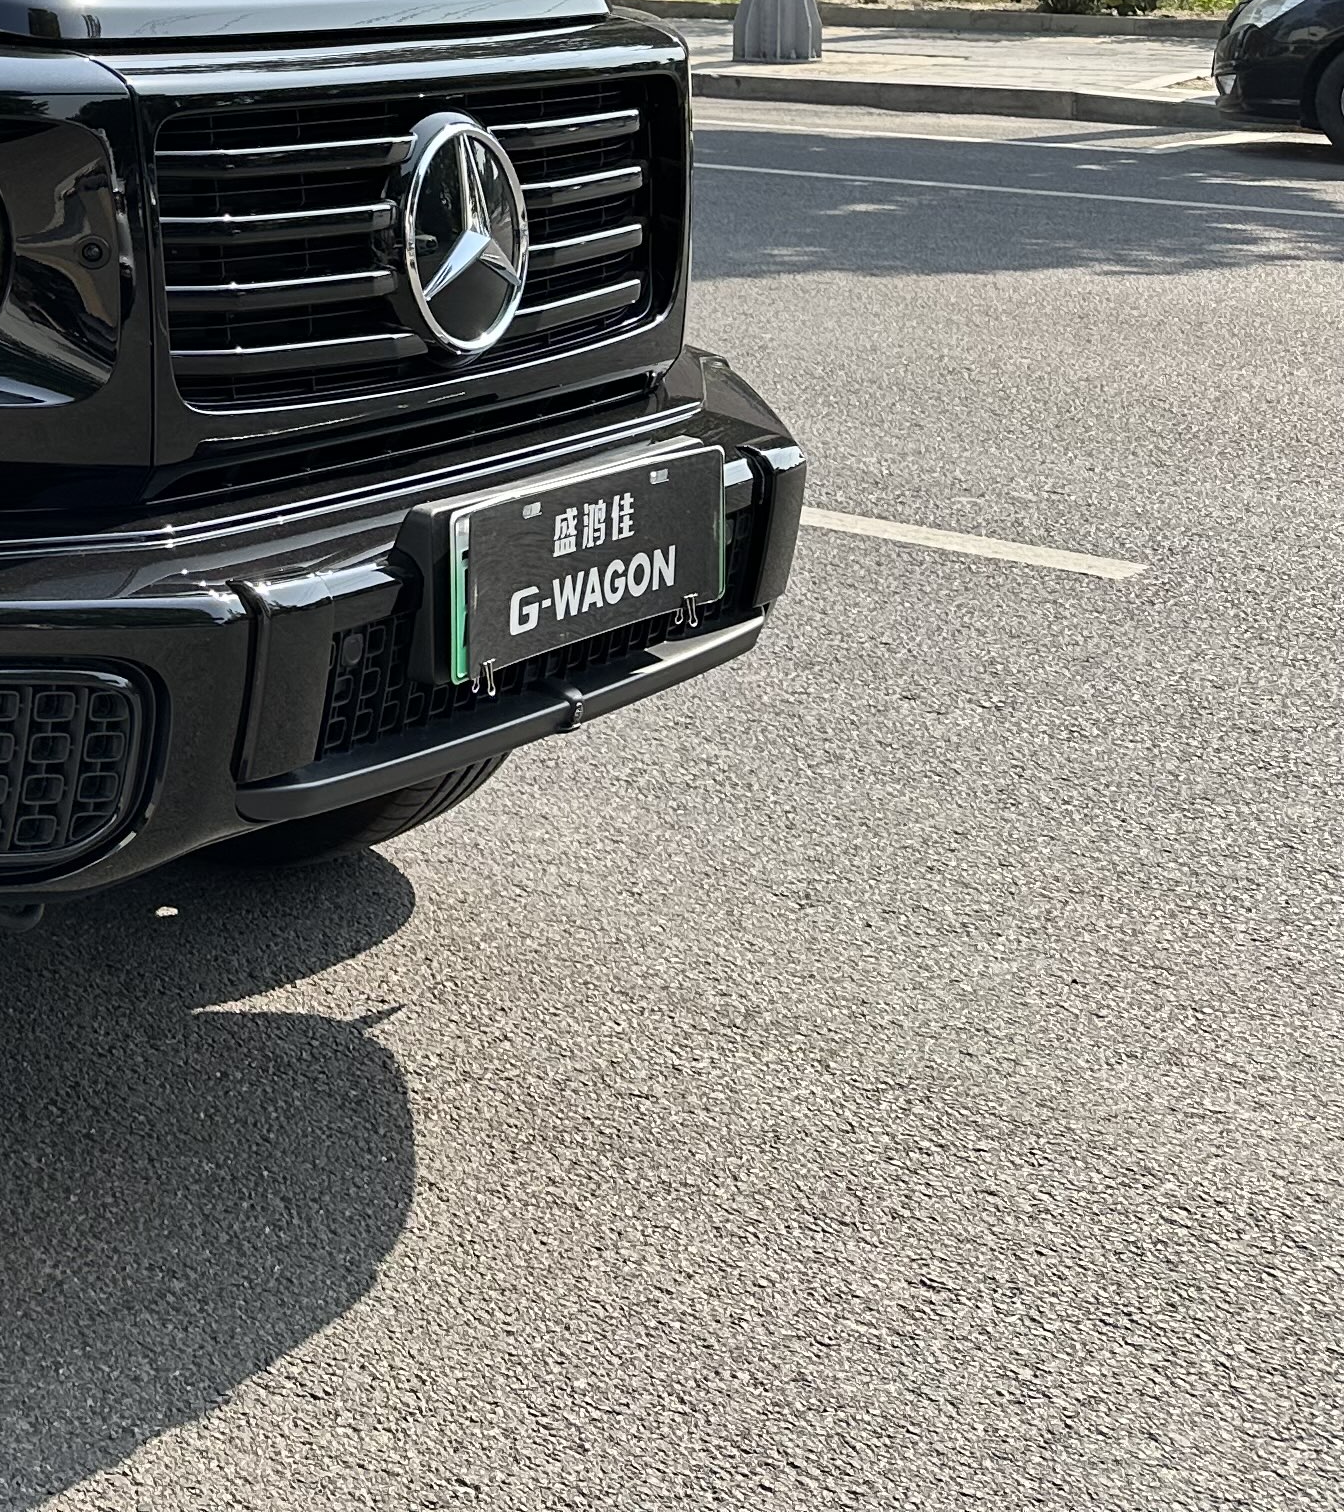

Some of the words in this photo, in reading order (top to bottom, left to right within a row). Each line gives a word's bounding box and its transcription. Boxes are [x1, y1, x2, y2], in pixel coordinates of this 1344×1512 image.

[552, 491, 635, 558] 盛鸿佳
[509, 545, 676, 636] G-WAGON
